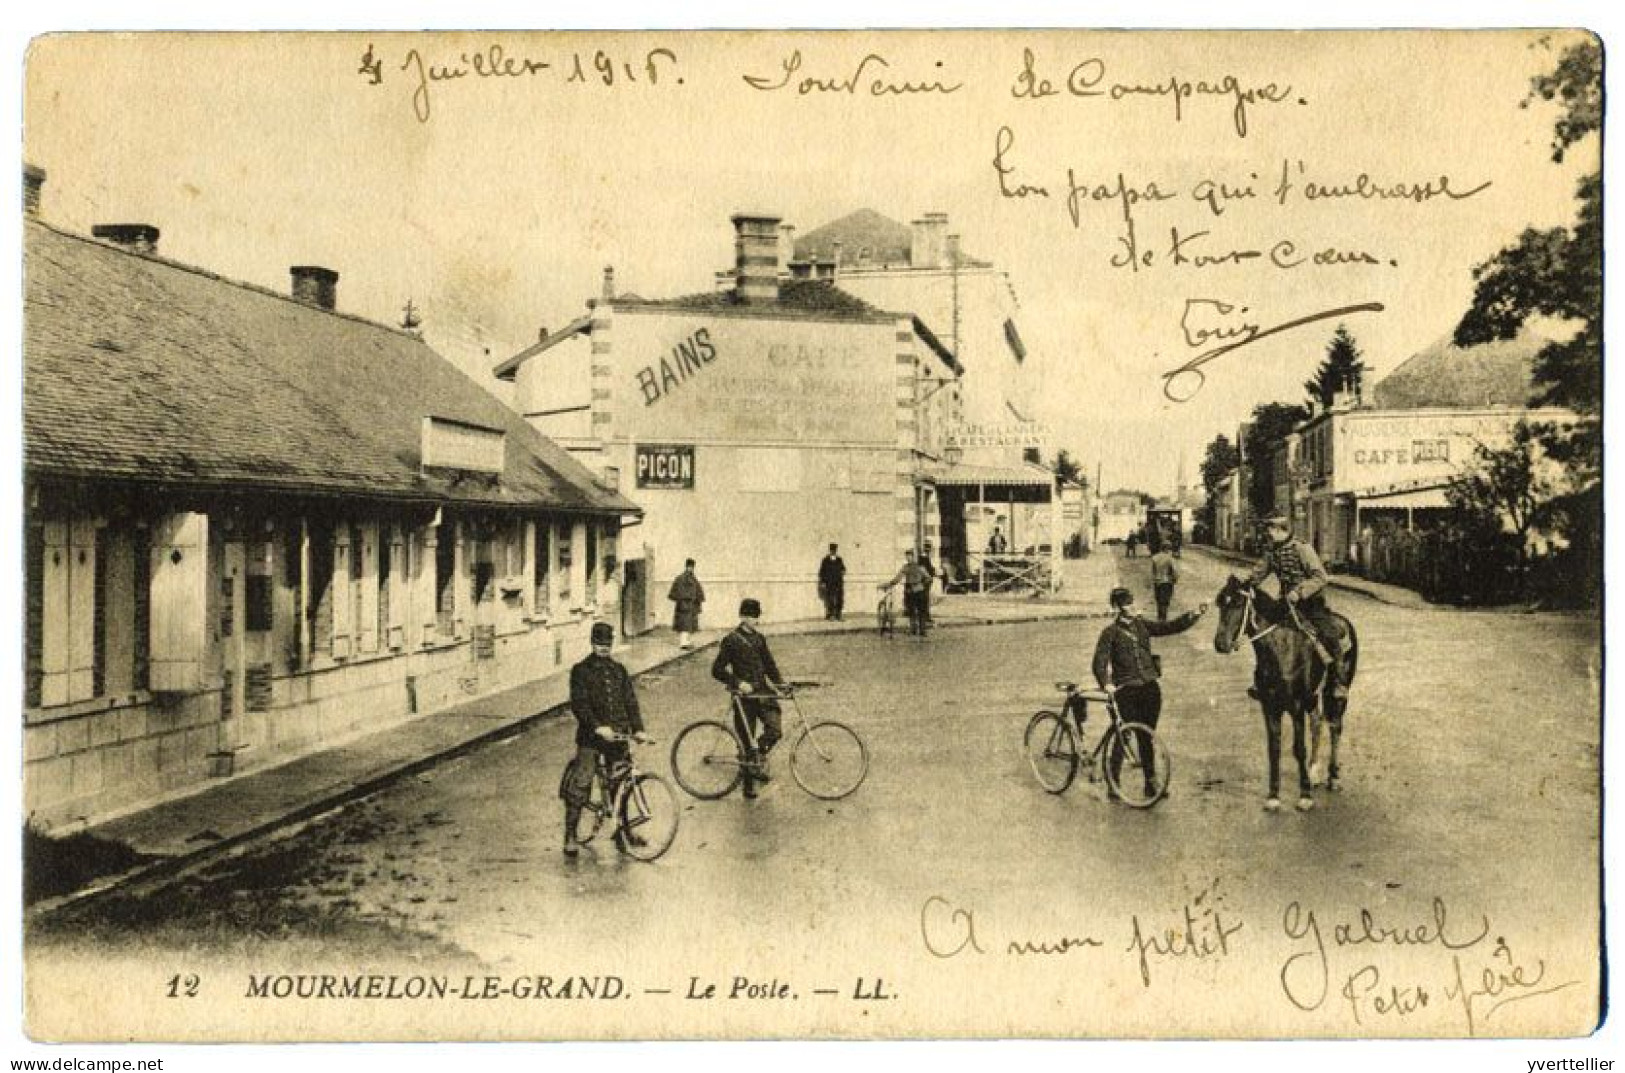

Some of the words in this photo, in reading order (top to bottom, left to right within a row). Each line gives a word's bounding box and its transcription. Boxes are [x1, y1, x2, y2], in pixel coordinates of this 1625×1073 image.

[400, 48, 551, 124] Juillet
[741, 48, 965, 97] Souvenir
[1011, 46, 1059, 99] de
[1066, 168, 1177, 230] papa
[1192, 171, 1259, 218] qui
[1168, 226, 1263, 267] tout
[634, 326, 717, 408] BAINS
[637, 453, 692, 480] PICON
[1006, 936, 1103, 956] mon
[1125, 904, 1244, 988] petit
